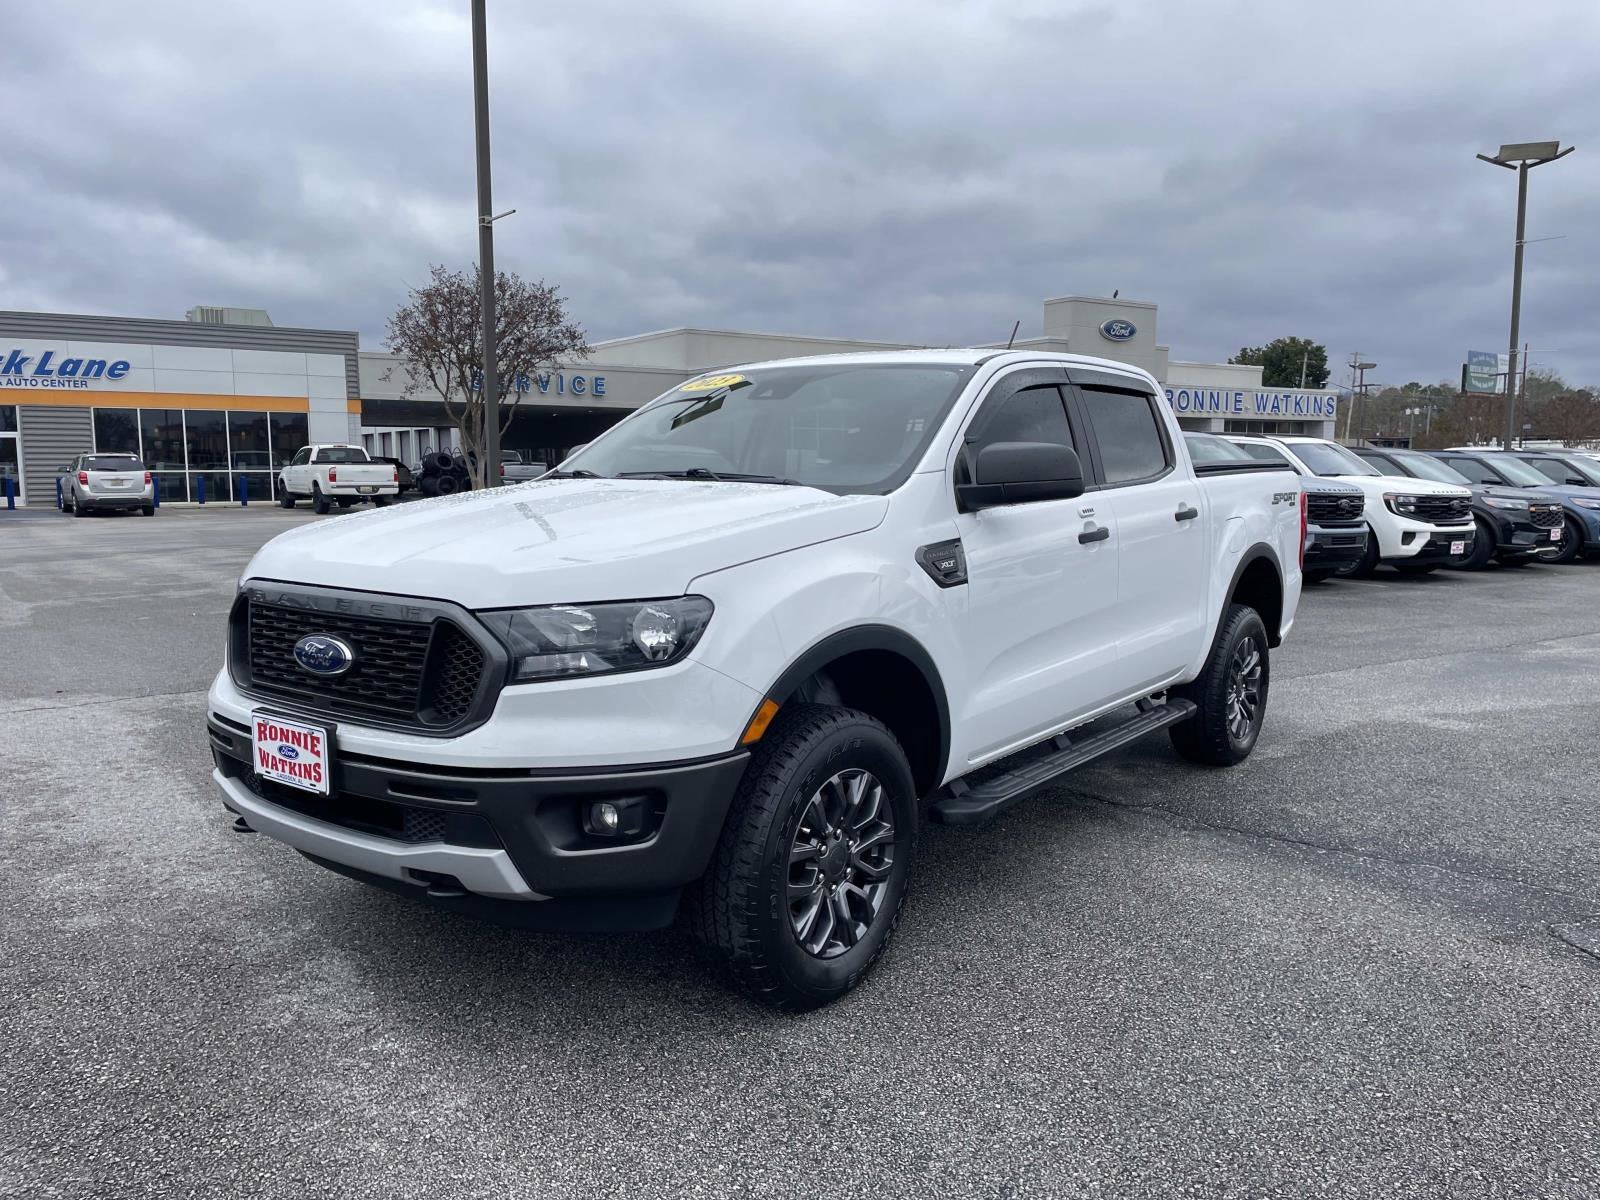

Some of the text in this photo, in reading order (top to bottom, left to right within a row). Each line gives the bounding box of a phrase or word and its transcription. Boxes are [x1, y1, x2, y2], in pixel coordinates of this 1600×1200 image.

[1110, 322, 1131, 336] Ford
[0, 349, 131, 379] k Lane
[5, 378, 39, 388] AUTO
[42, 378, 88, 388] CENTER
[472, 368, 606, 396] SRVICE
[1255, 392, 1336, 415] WATKINS
[1272, 491, 1298, 505] SPORT
[257, 722, 321, 759] RONNIE
[258, 746, 322, 783] WATKINS
[280, 747, 297, 759] Ford
